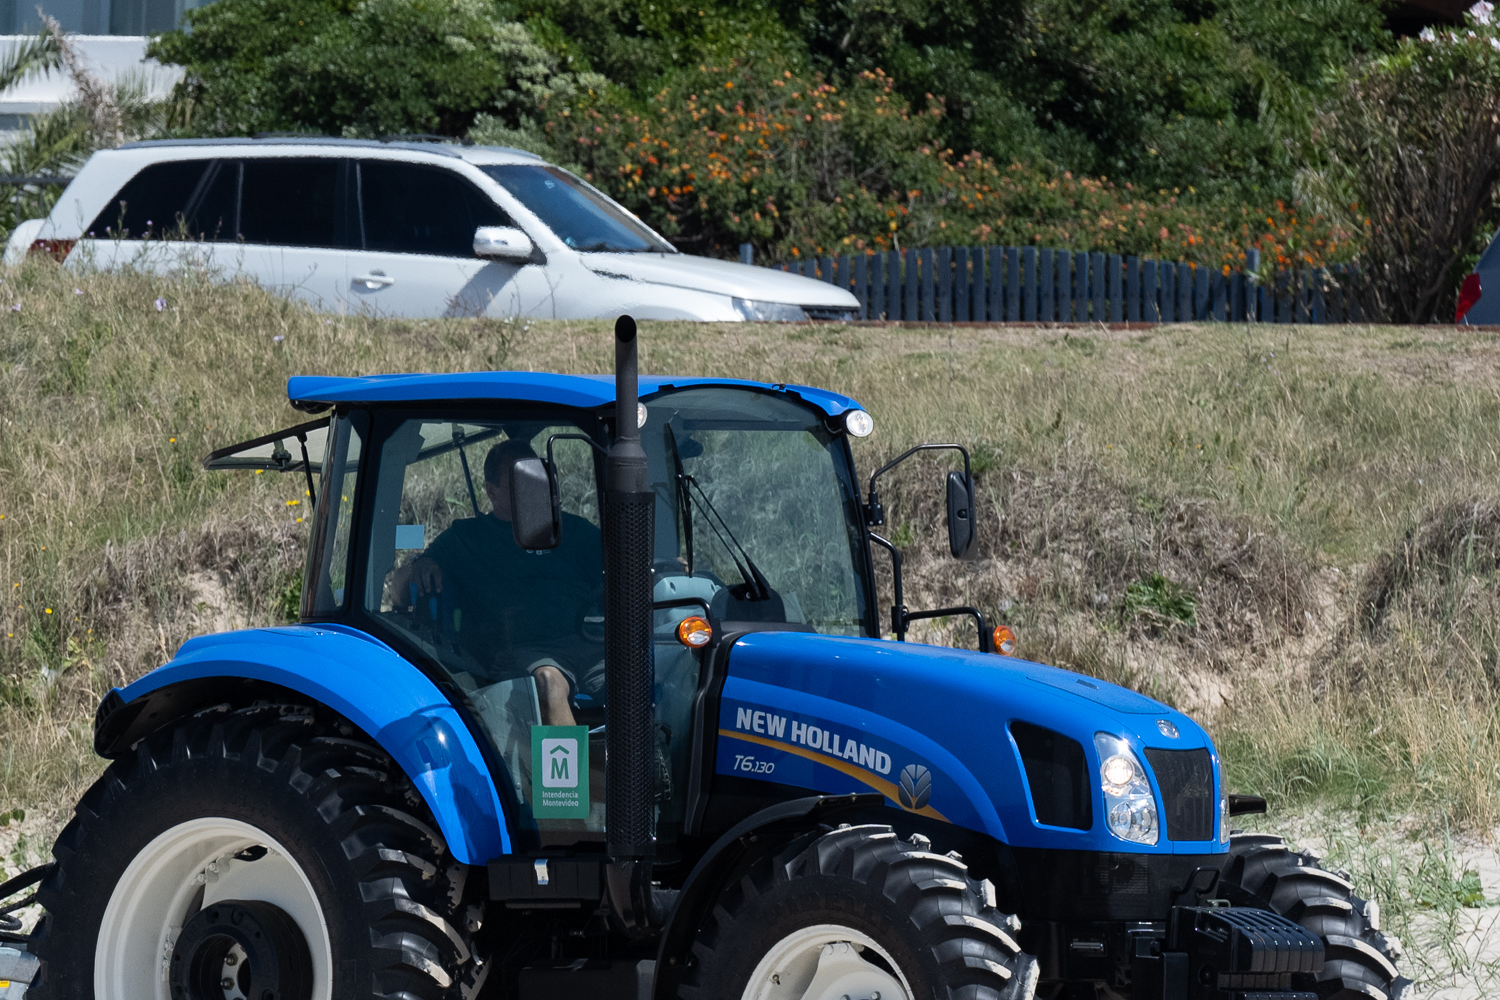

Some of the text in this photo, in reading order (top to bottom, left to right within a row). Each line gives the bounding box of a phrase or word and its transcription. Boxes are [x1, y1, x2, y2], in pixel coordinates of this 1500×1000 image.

[735, 707, 892, 775] NEW HOLLAND
[550, 757, 570, 780] M
[733, 754, 775, 775] T6.130
[542, 790, 579, 799] Intendencia
[542, 799, 579, 807] Montevideo
